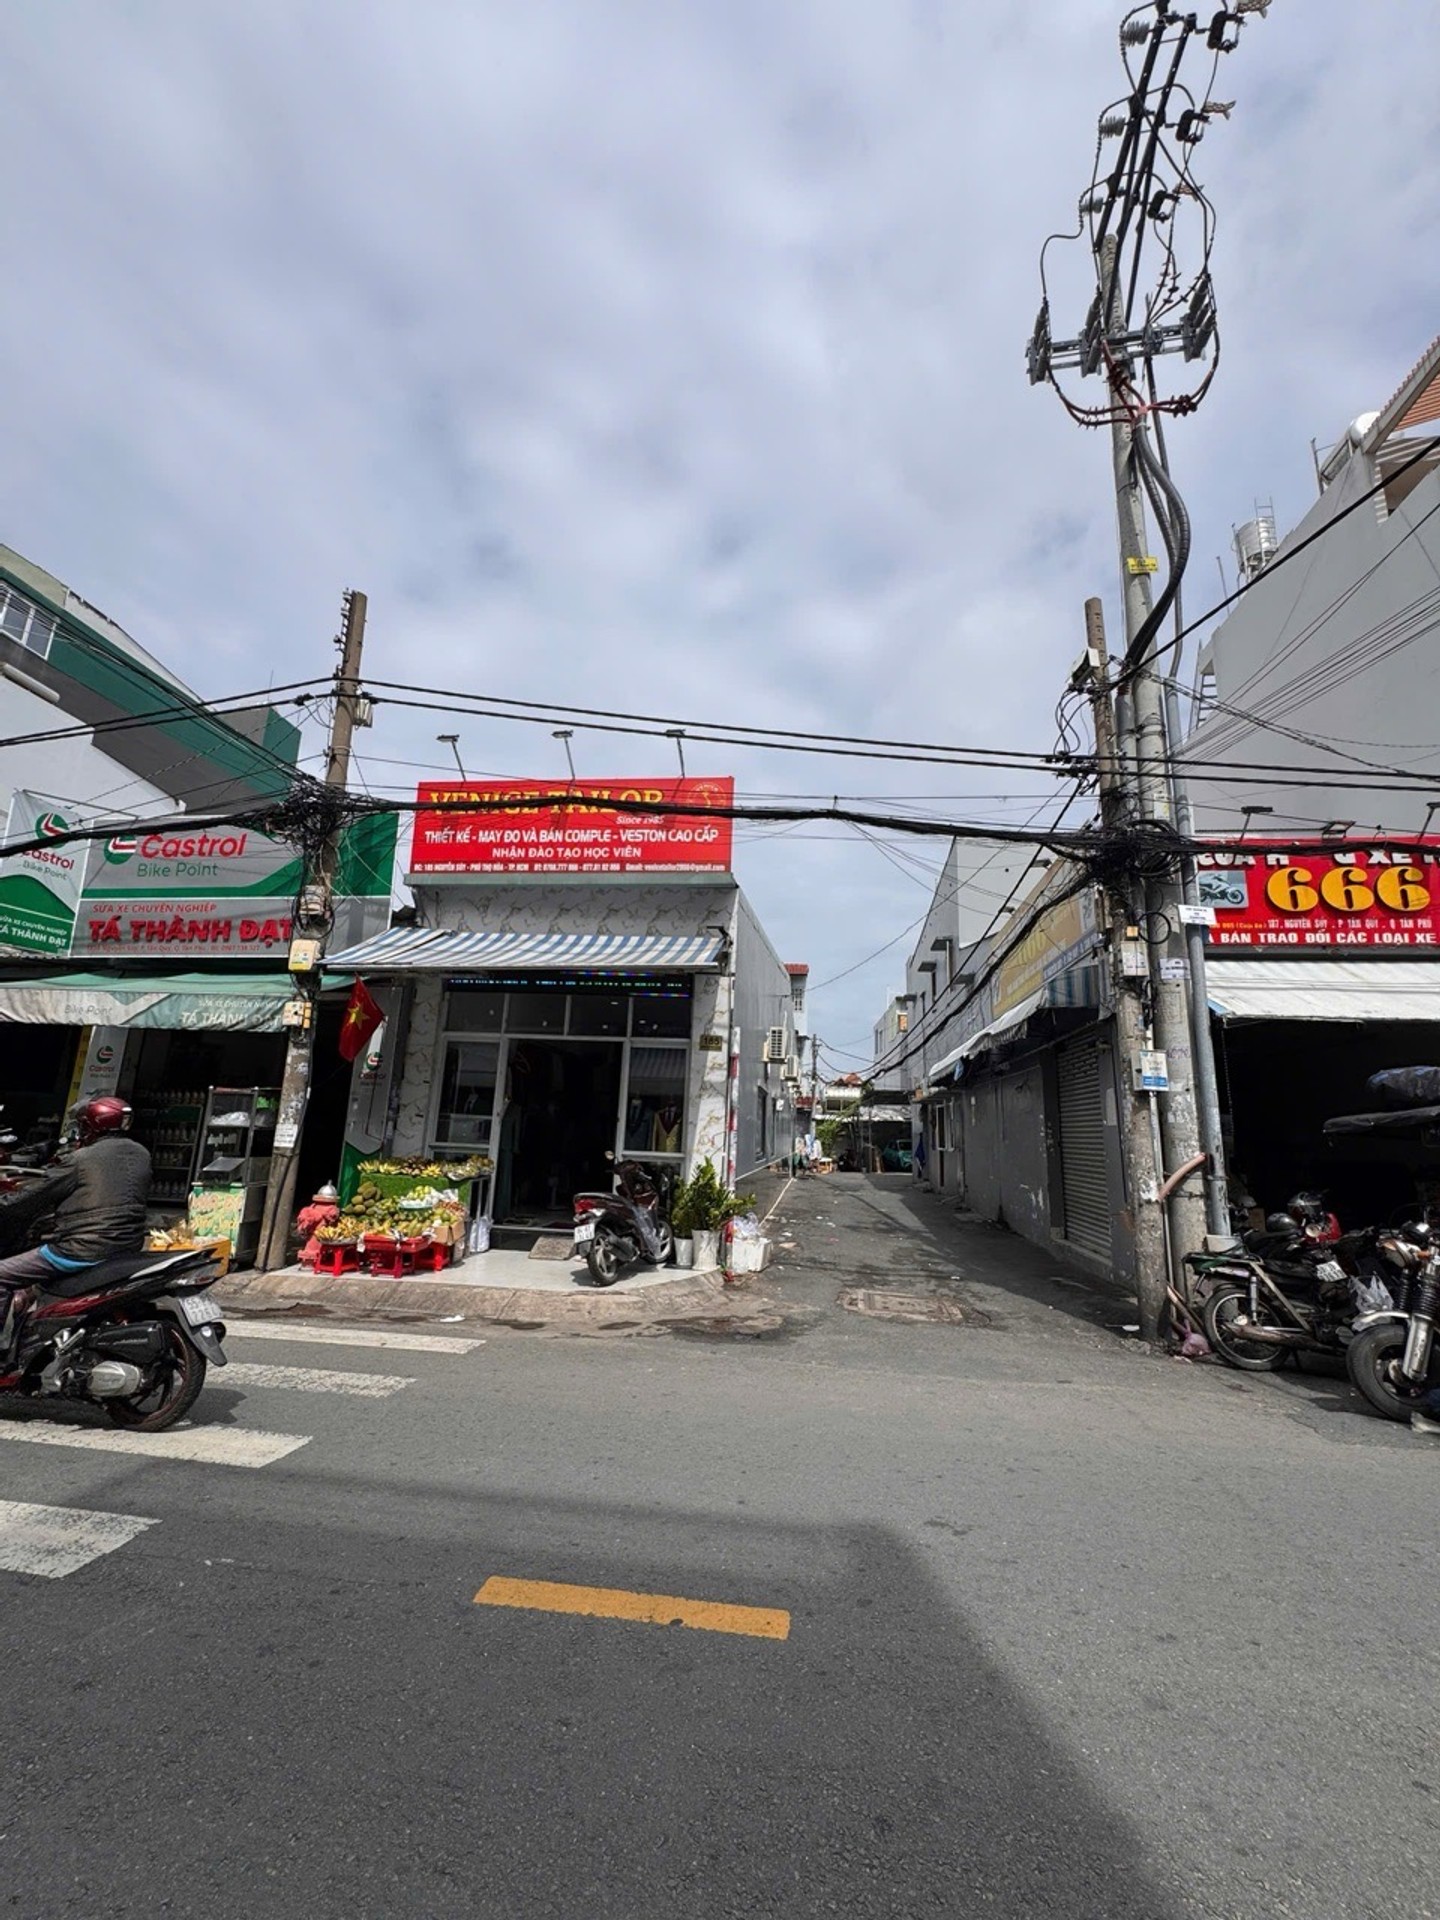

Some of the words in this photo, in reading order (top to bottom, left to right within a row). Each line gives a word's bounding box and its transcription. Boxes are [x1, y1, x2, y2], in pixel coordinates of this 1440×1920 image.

[616, 815, 641, 825] Since
[425, 826, 454, 843] THIẾT
[456, 825, 473, 843] KẾ
[478, 829, 503, 843] MAY
[522, 826, 537, 842] VÀ
[539, 827, 563, 842] BÁN
[564, 829, 612, 843] COMPLE
[619, 829, 666, 842] VESTON
[668, 829, 692, 842] CAO
[694, 823, 719, 842] CẤP
[141, 833, 247, 858] Castrol
[492, 846, 525, 859] NHẬN
[528, 846, 554, 858] ĐÀO
[556, 848, 582, 860] TẠO
[584, 848, 610, 860] HỌC
[613, 845, 641, 858] VIÊN
[44, 867, 68, 881] Point
[136, 863, 171, 877] Bike
[175, 862, 218, 877] Point
[1267, 866, 1431, 912] 666
[92, 902, 115, 913] SỬA
[117, 904, 129, 912] XE
[131, 902, 174, 913] CHUYÊN
[178, 901, 217, 913] NGHIỆP
[11, 927, 48, 943] THÀNH
[48, 935, 67, 949] ĐẠT
[89, 914, 122, 943] TÁ
[130, 913, 230, 944] THÀNH
[238, 917, 292, 948] ĐẠT
[1220, 931, 1252, 944] BÁN
[1258, 933, 1299, 944] TRAO
[1305, 928, 1331, 944] ĐỔI
[1336, 931, 1368, 944] CÁC
[1374, 933, 1410, 945] LOẠI
[1415, 933, 1438, 944] XE
[87, 1005, 113, 1016] Point
